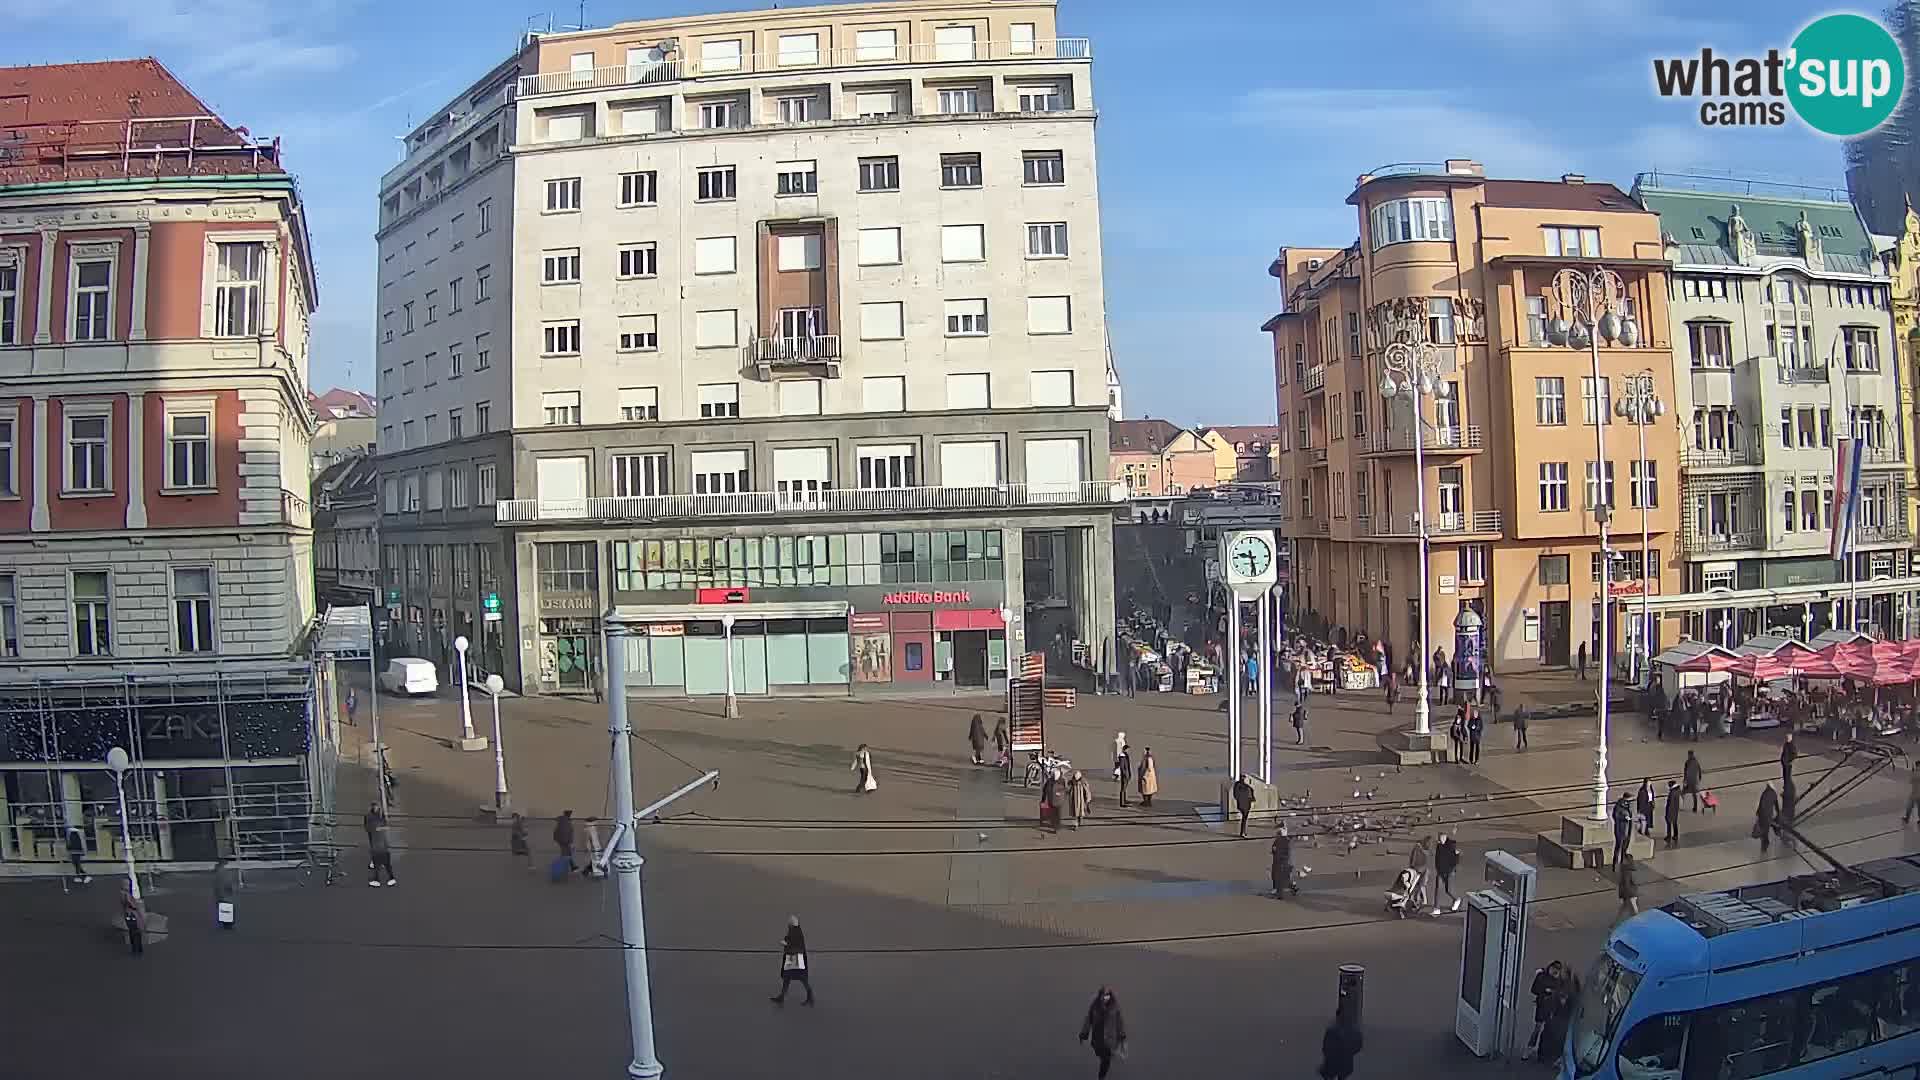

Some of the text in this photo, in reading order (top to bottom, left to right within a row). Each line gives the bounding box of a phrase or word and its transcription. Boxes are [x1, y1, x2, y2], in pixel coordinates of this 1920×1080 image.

[883, 590, 971, 604] Addiko Bank
[143, 714, 222, 739] ZAKS
